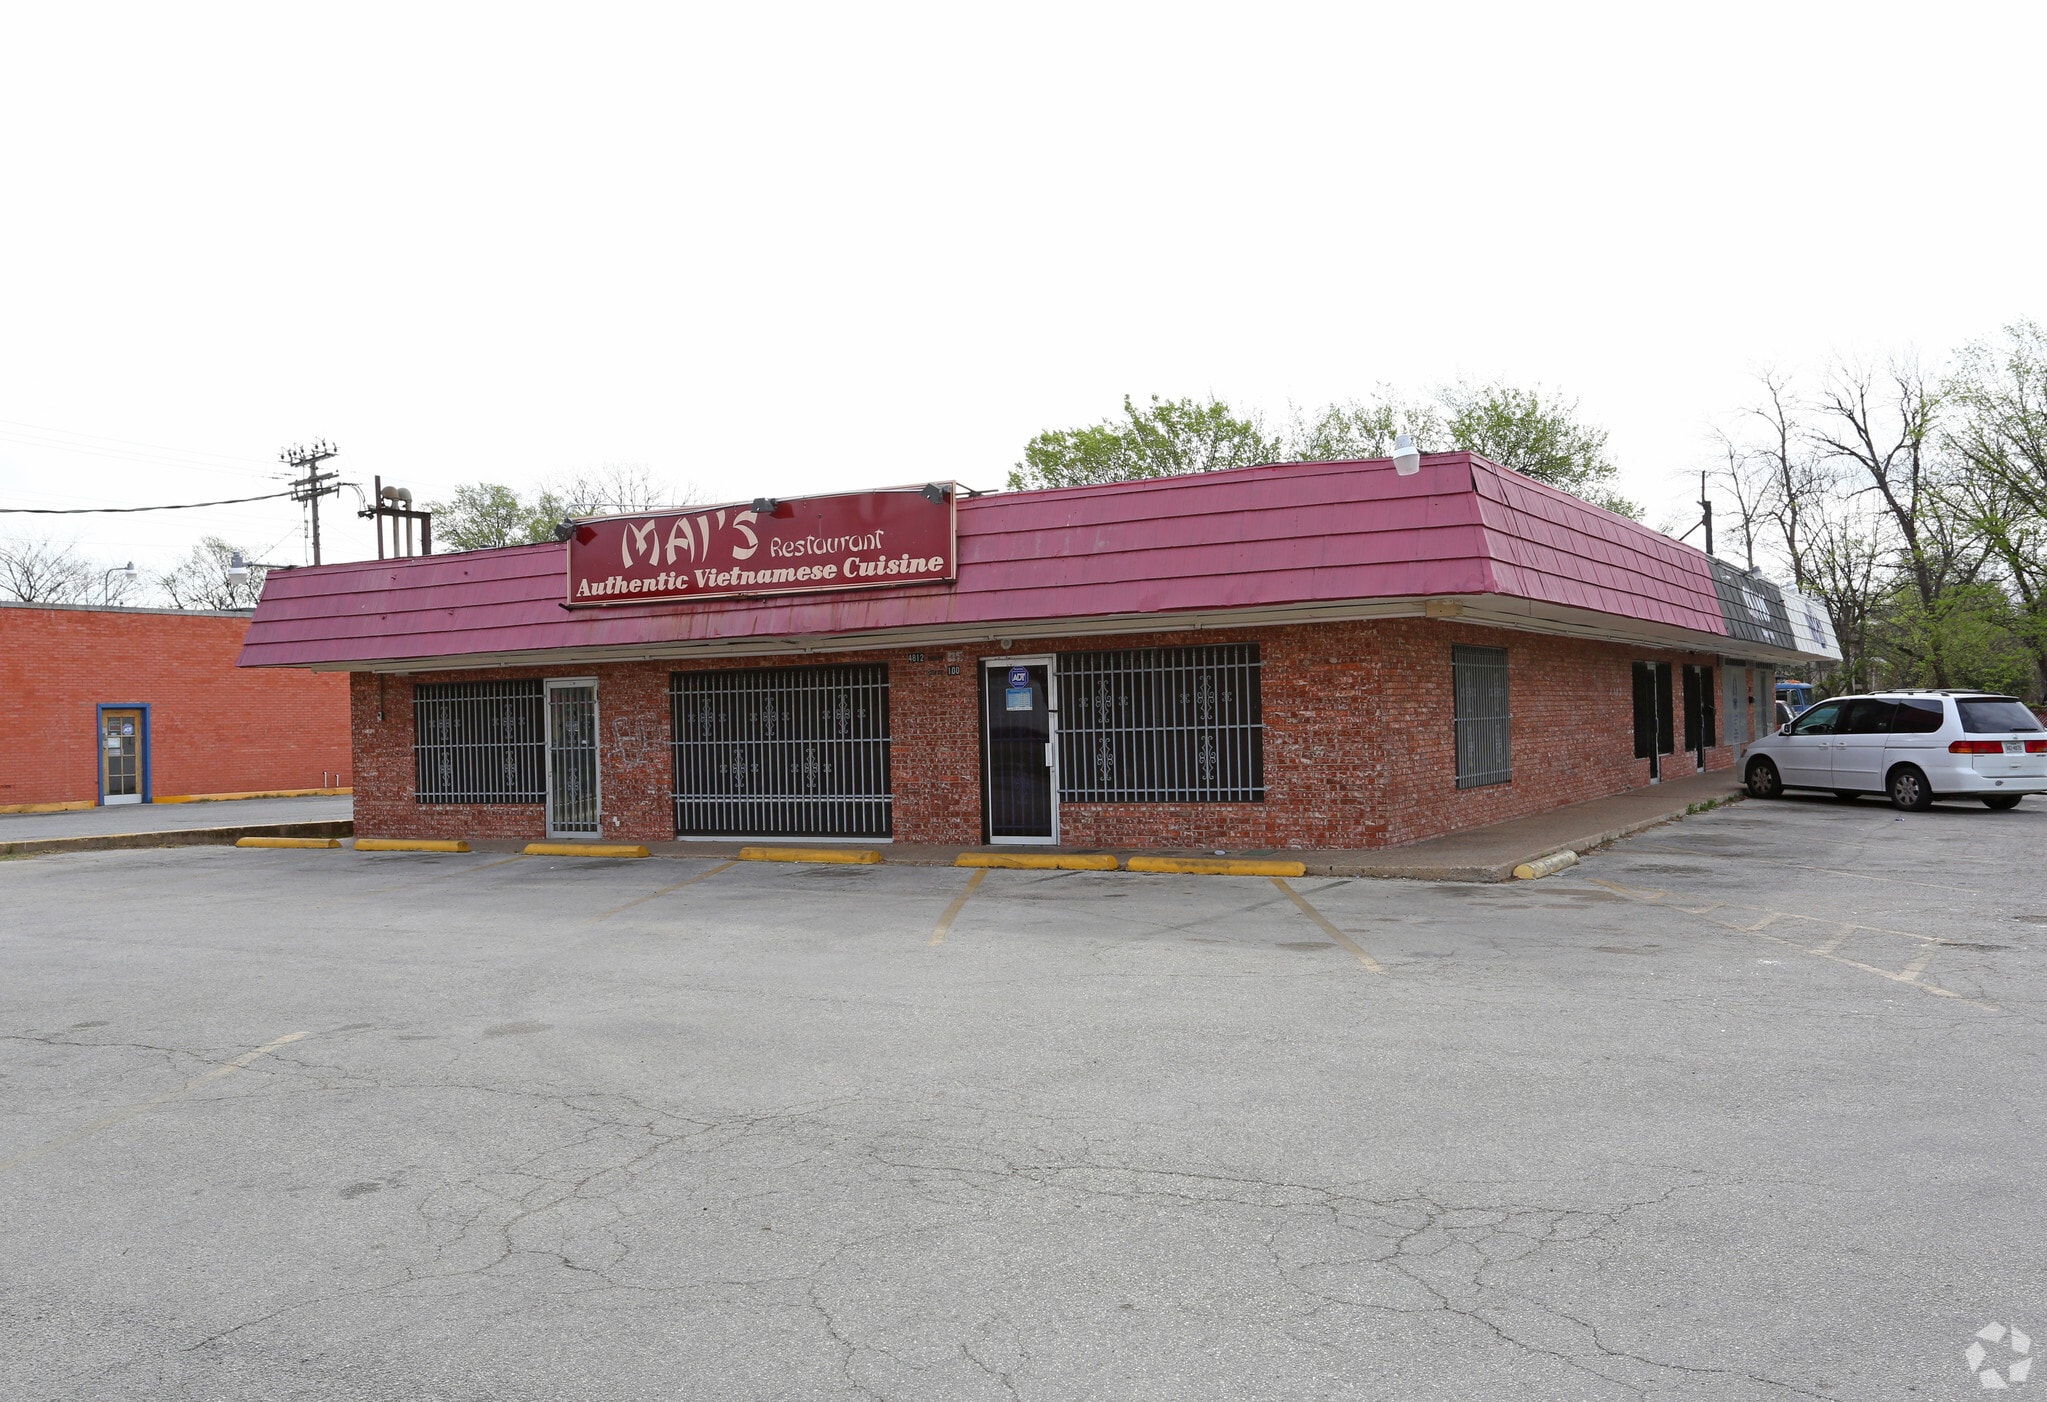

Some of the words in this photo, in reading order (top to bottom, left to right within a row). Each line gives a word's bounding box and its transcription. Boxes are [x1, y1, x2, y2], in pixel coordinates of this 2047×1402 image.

[621, 510, 759, 568] MAI'S
[770, 529, 884, 557] Restaurant
[576, 574, 689, 597] Authentic
[694, 564, 837, 588] Vietnamese
[843, 553, 943, 577] Cuisine
[948, 666, 960, 675] 100
[1012, 673, 1026, 681] ADT
